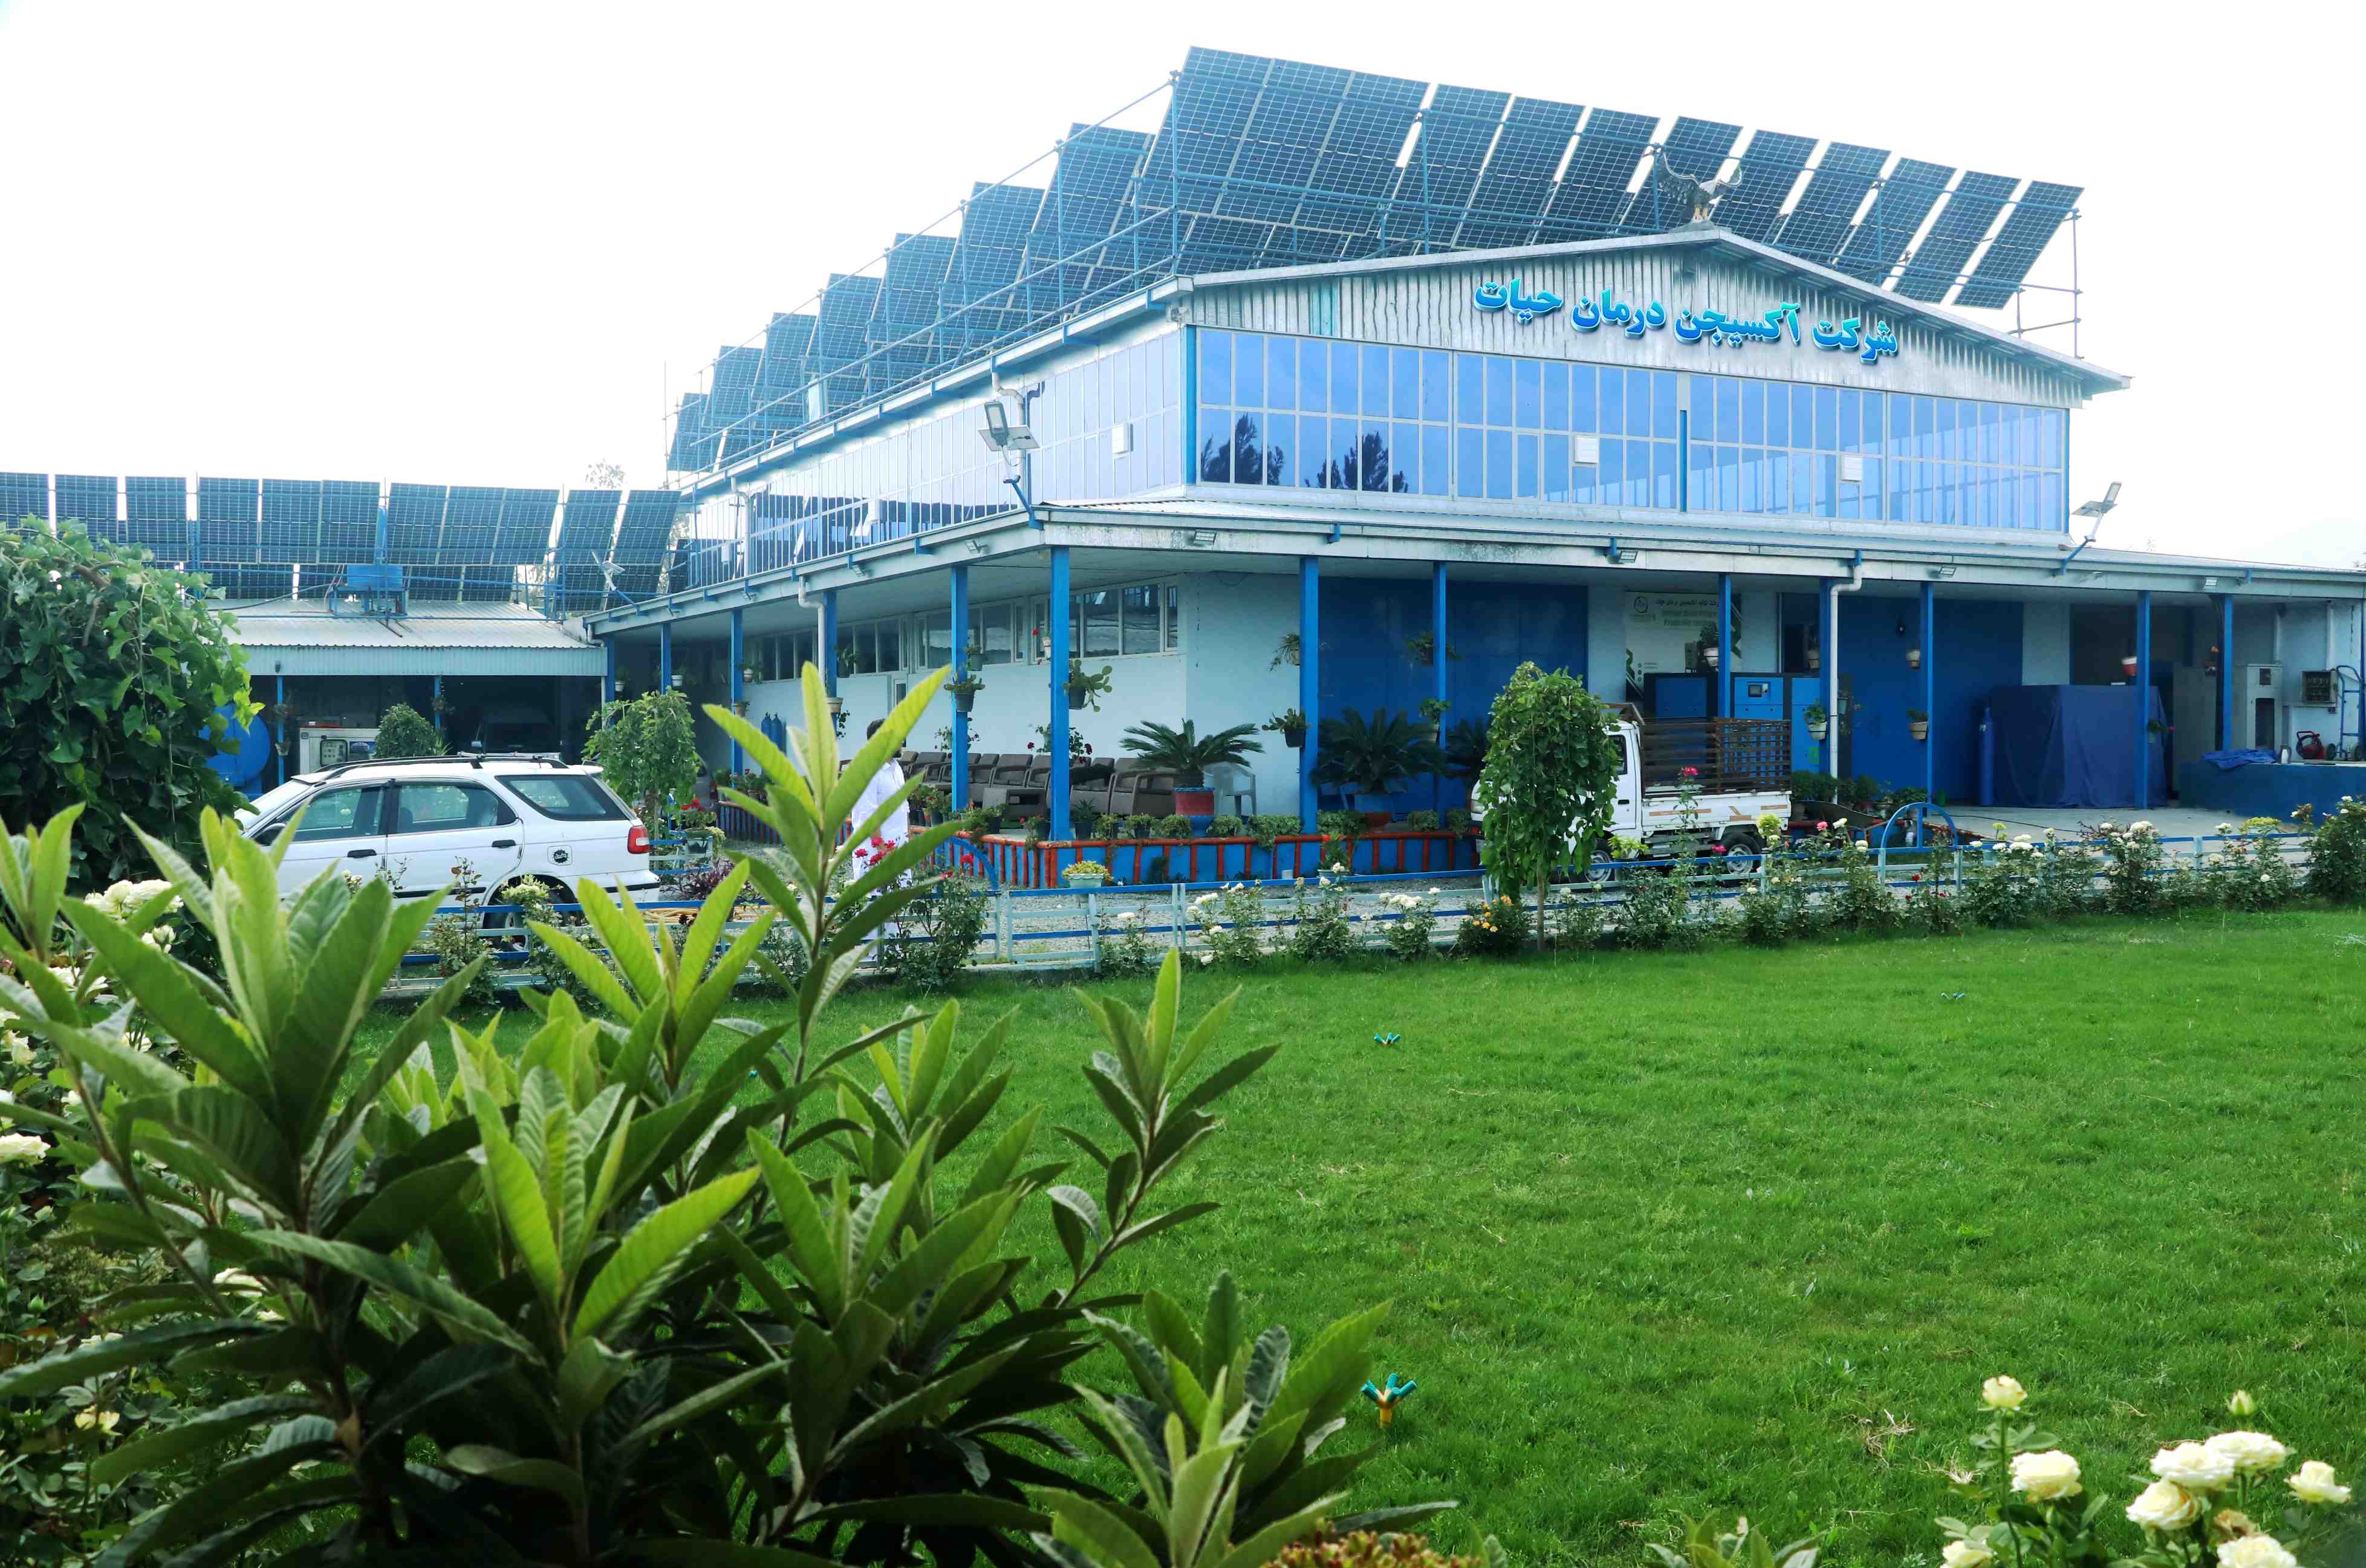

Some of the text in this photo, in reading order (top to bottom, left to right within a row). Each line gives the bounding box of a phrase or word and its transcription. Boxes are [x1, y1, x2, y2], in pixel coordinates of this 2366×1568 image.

[1474, 277, 1898, 363] شرکت آکسیجن درمان حیات
